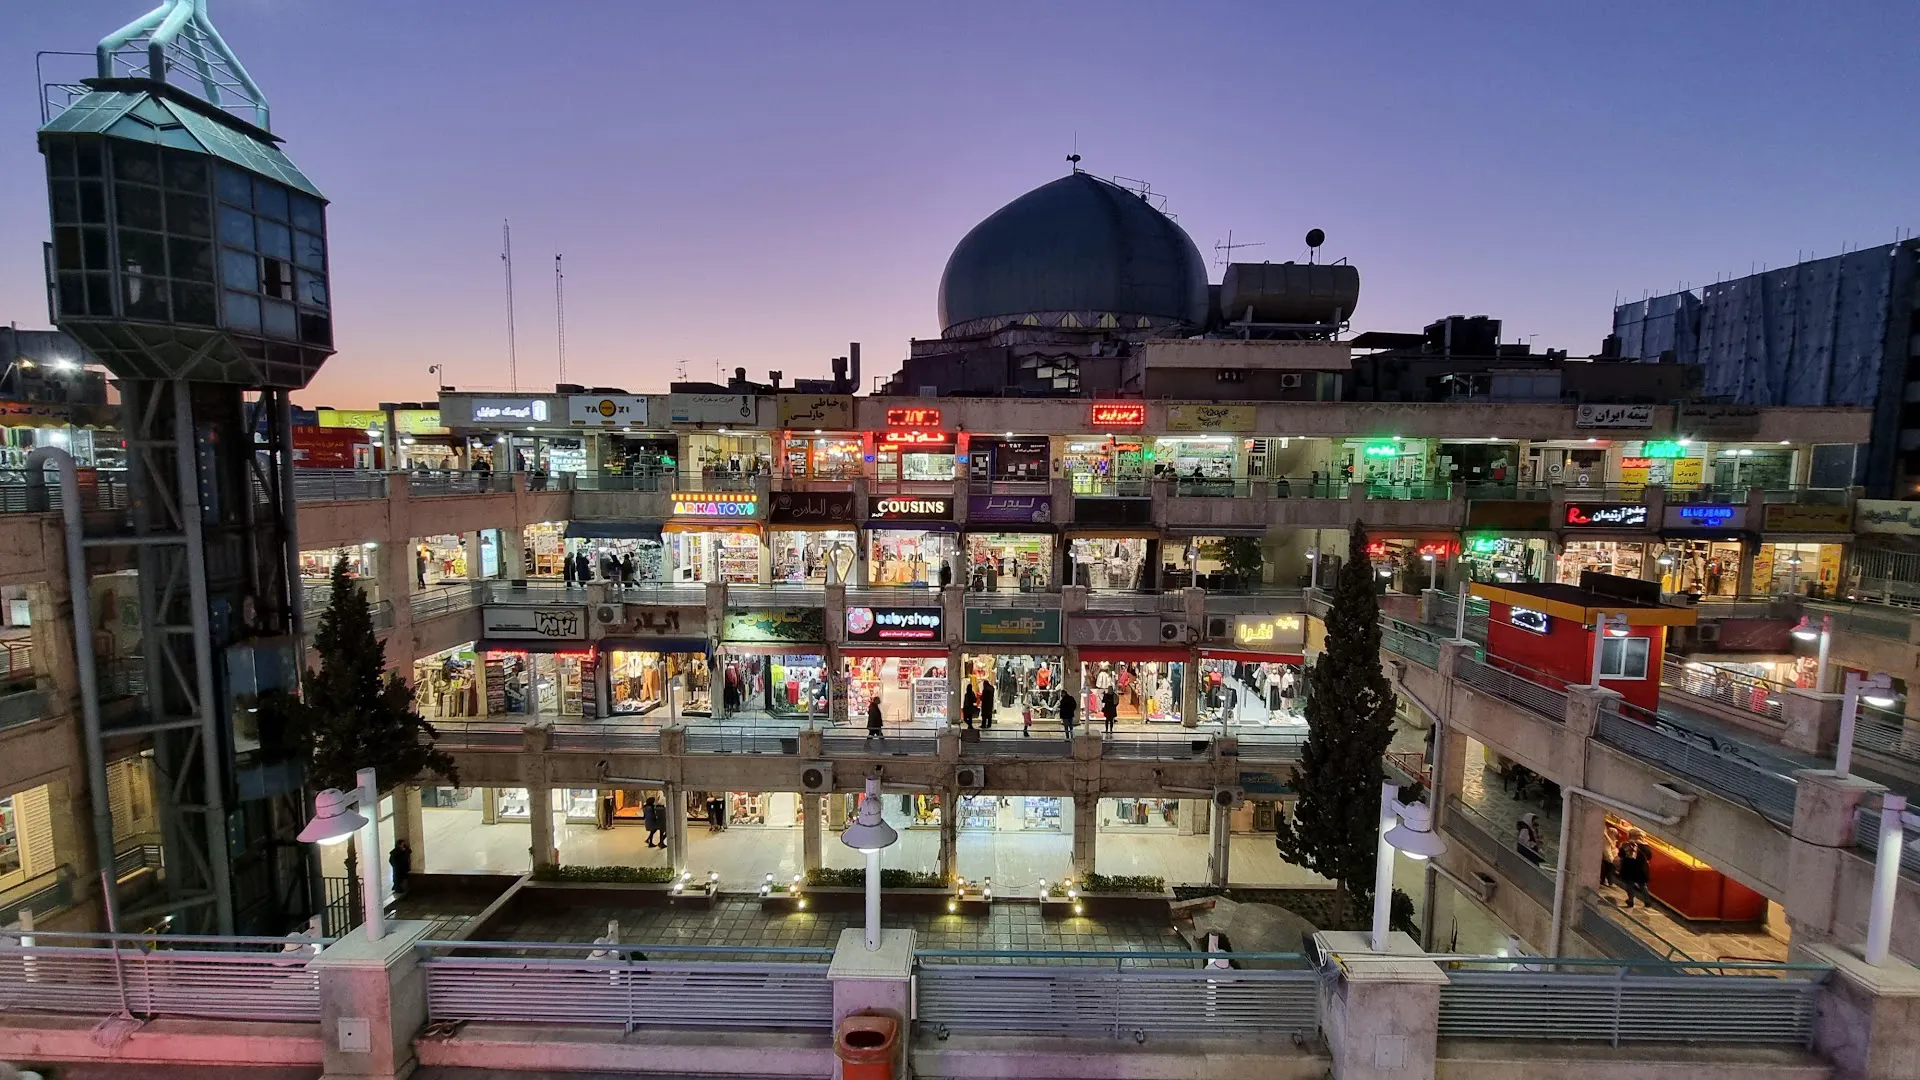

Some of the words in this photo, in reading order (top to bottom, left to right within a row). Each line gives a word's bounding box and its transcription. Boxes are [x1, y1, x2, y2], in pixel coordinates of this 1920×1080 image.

[811, 397, 839, 410] خیاطی
[1595, 409, 1625, 423] ایران
[1627, 411, 1649, 423] بیمه
[673, 501, 755, 516] ARKATOYS
[877, 500, 945, 514] COUSINS
[875, 611, 940, 629] babyshop
[1086, 618, 1143, 642] YAS
